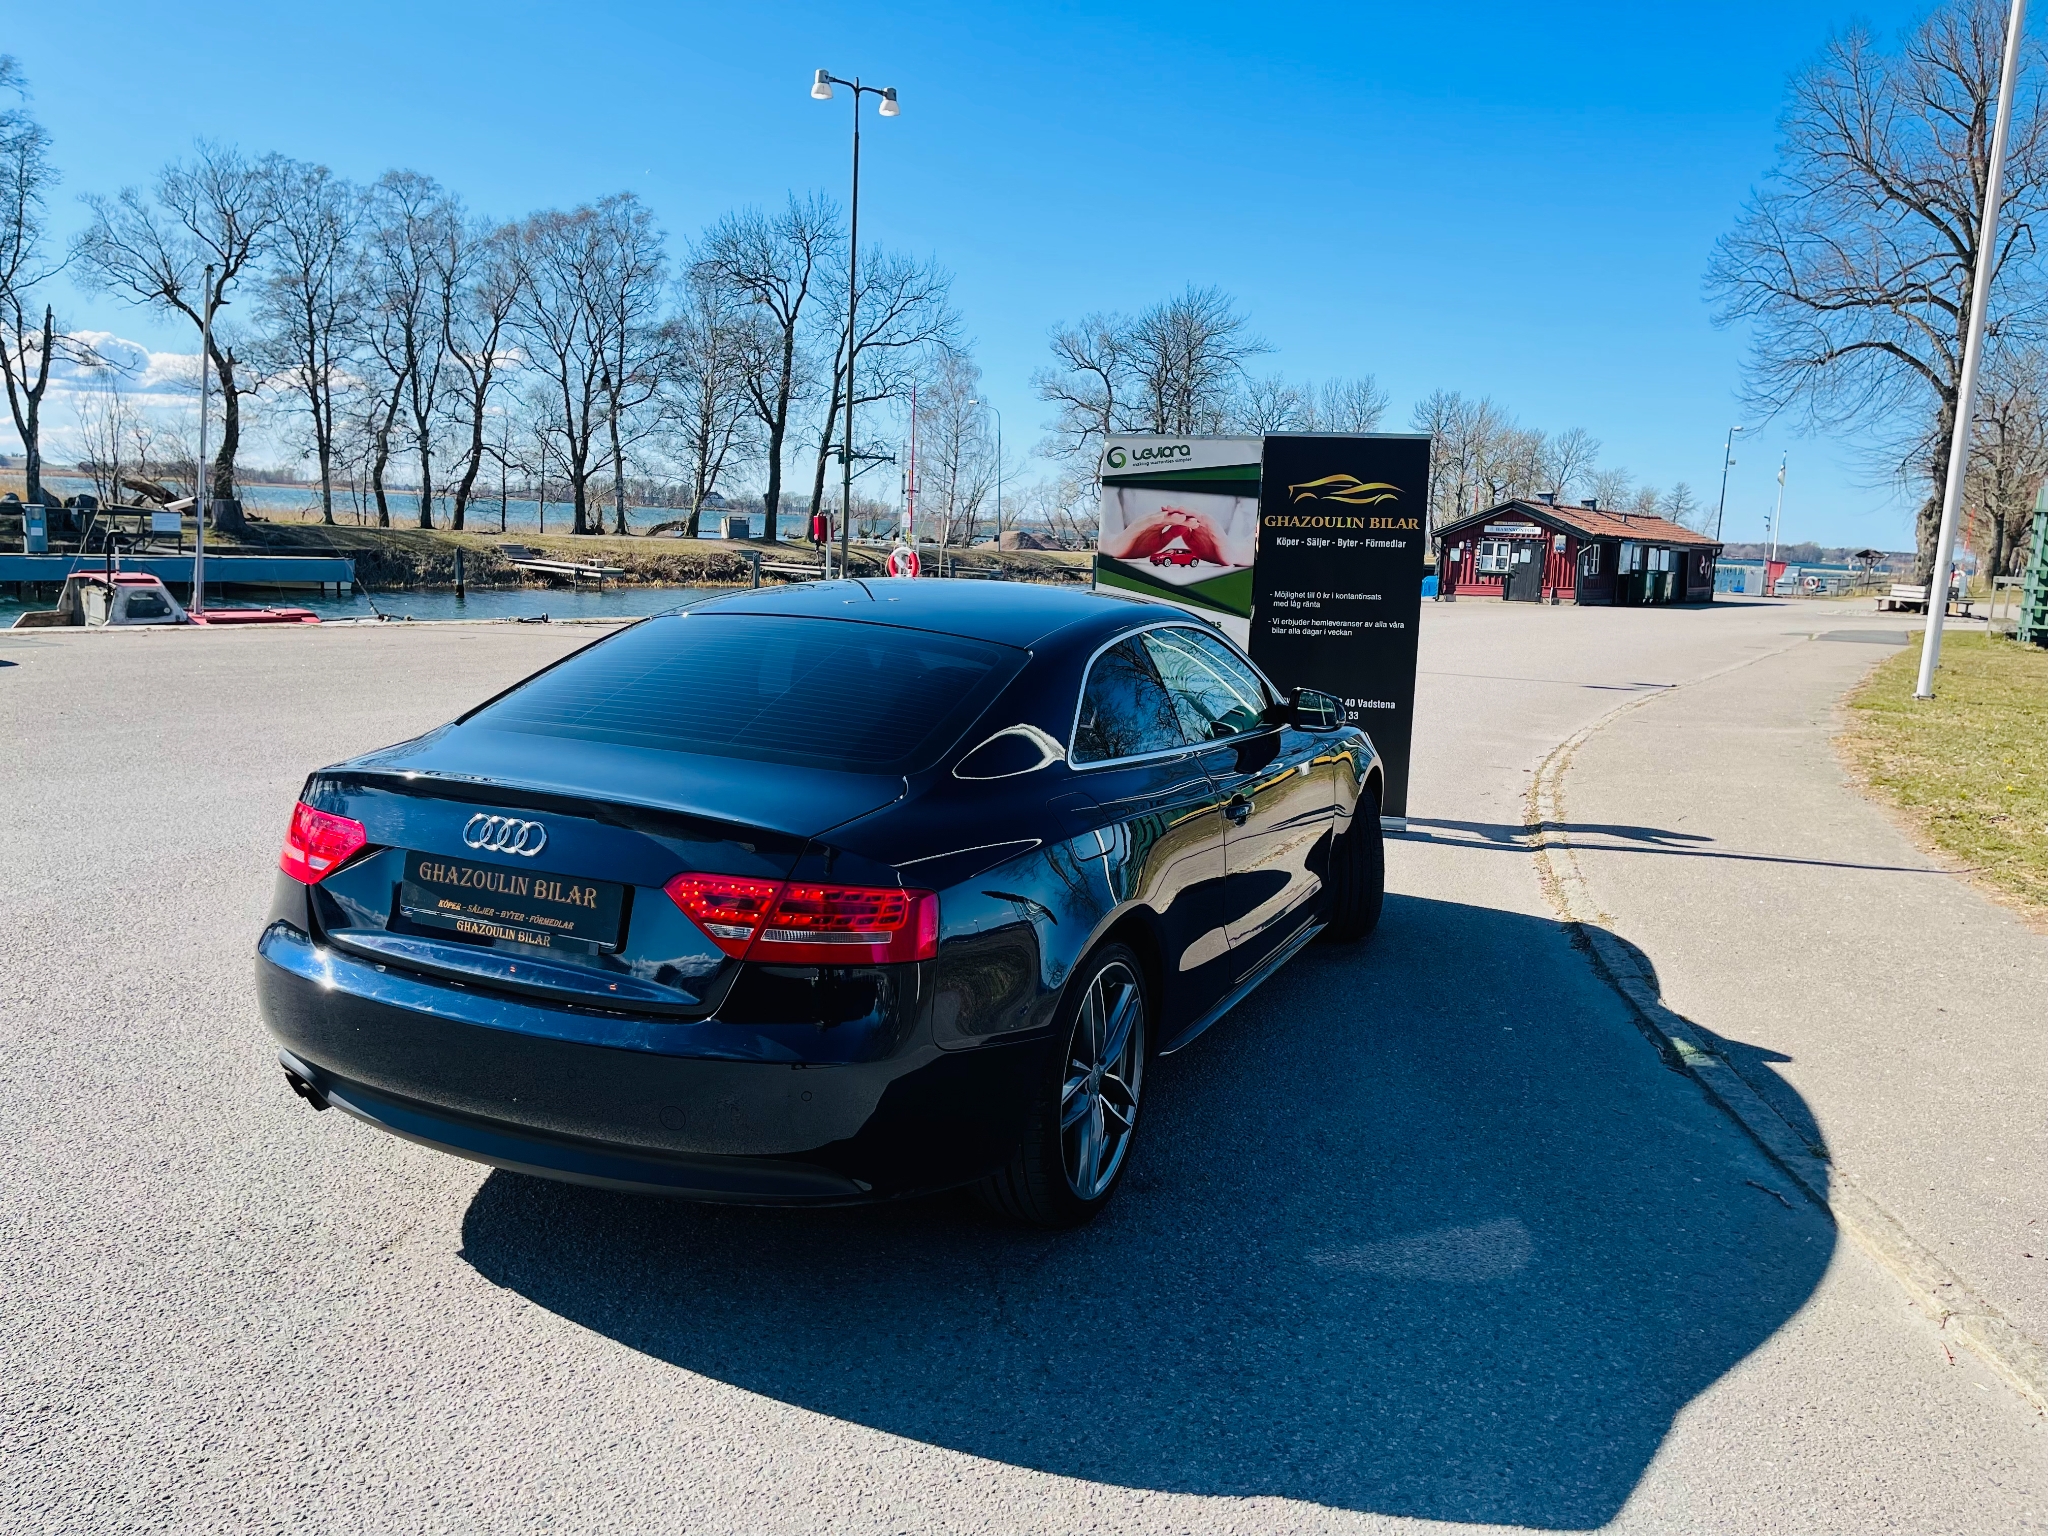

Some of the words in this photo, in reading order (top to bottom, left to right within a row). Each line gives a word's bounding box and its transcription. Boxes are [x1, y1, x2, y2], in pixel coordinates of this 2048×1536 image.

[1264, 515, 1365, 529] GHAZOULIN
[1369, 517, 1420, 530] BILAR
[1276, 537, 1300, 547] Köper
[1306, 537, 1331, 547] Säljer
[1337, 538, 1359, 548] Byter
[1365, 539, 1407, 548] Förmedlar
[1274, 590, 1306, 600] Möjlighet
[1307, 591, 1316, 599] till
[1335, 592, 1382, 600] kontantinsats
[1290, 600, 1301, 609] låg
[1281, 619, 1311, 628] erbjuder
[1374, 620, 1388, 628] alla
[1388, 620, 1405, 629] våra
[1301, 628, 1322, 637] dagar
[1327, 628, 1353, 636] veckan
[1344, 698, 1355, 707] 40
[1357, 698, 1396, 709] Vadstena
[1348, 711, 1359, 720] 33
[419, 861, 530, 896] GHAZOULIN
[533, 879, 597, 909] BILAR
[437, 899, 461, 911] KÖPER
[467, 903, 495, 917] SÄLJER
[499, 910, 525, 922] BYTER
[529, 914, 575, 930] FÖRMEDLAR
[456, 921, 515, 941] GHAZOULIN
[517, 931, 550, 947] BILAR
